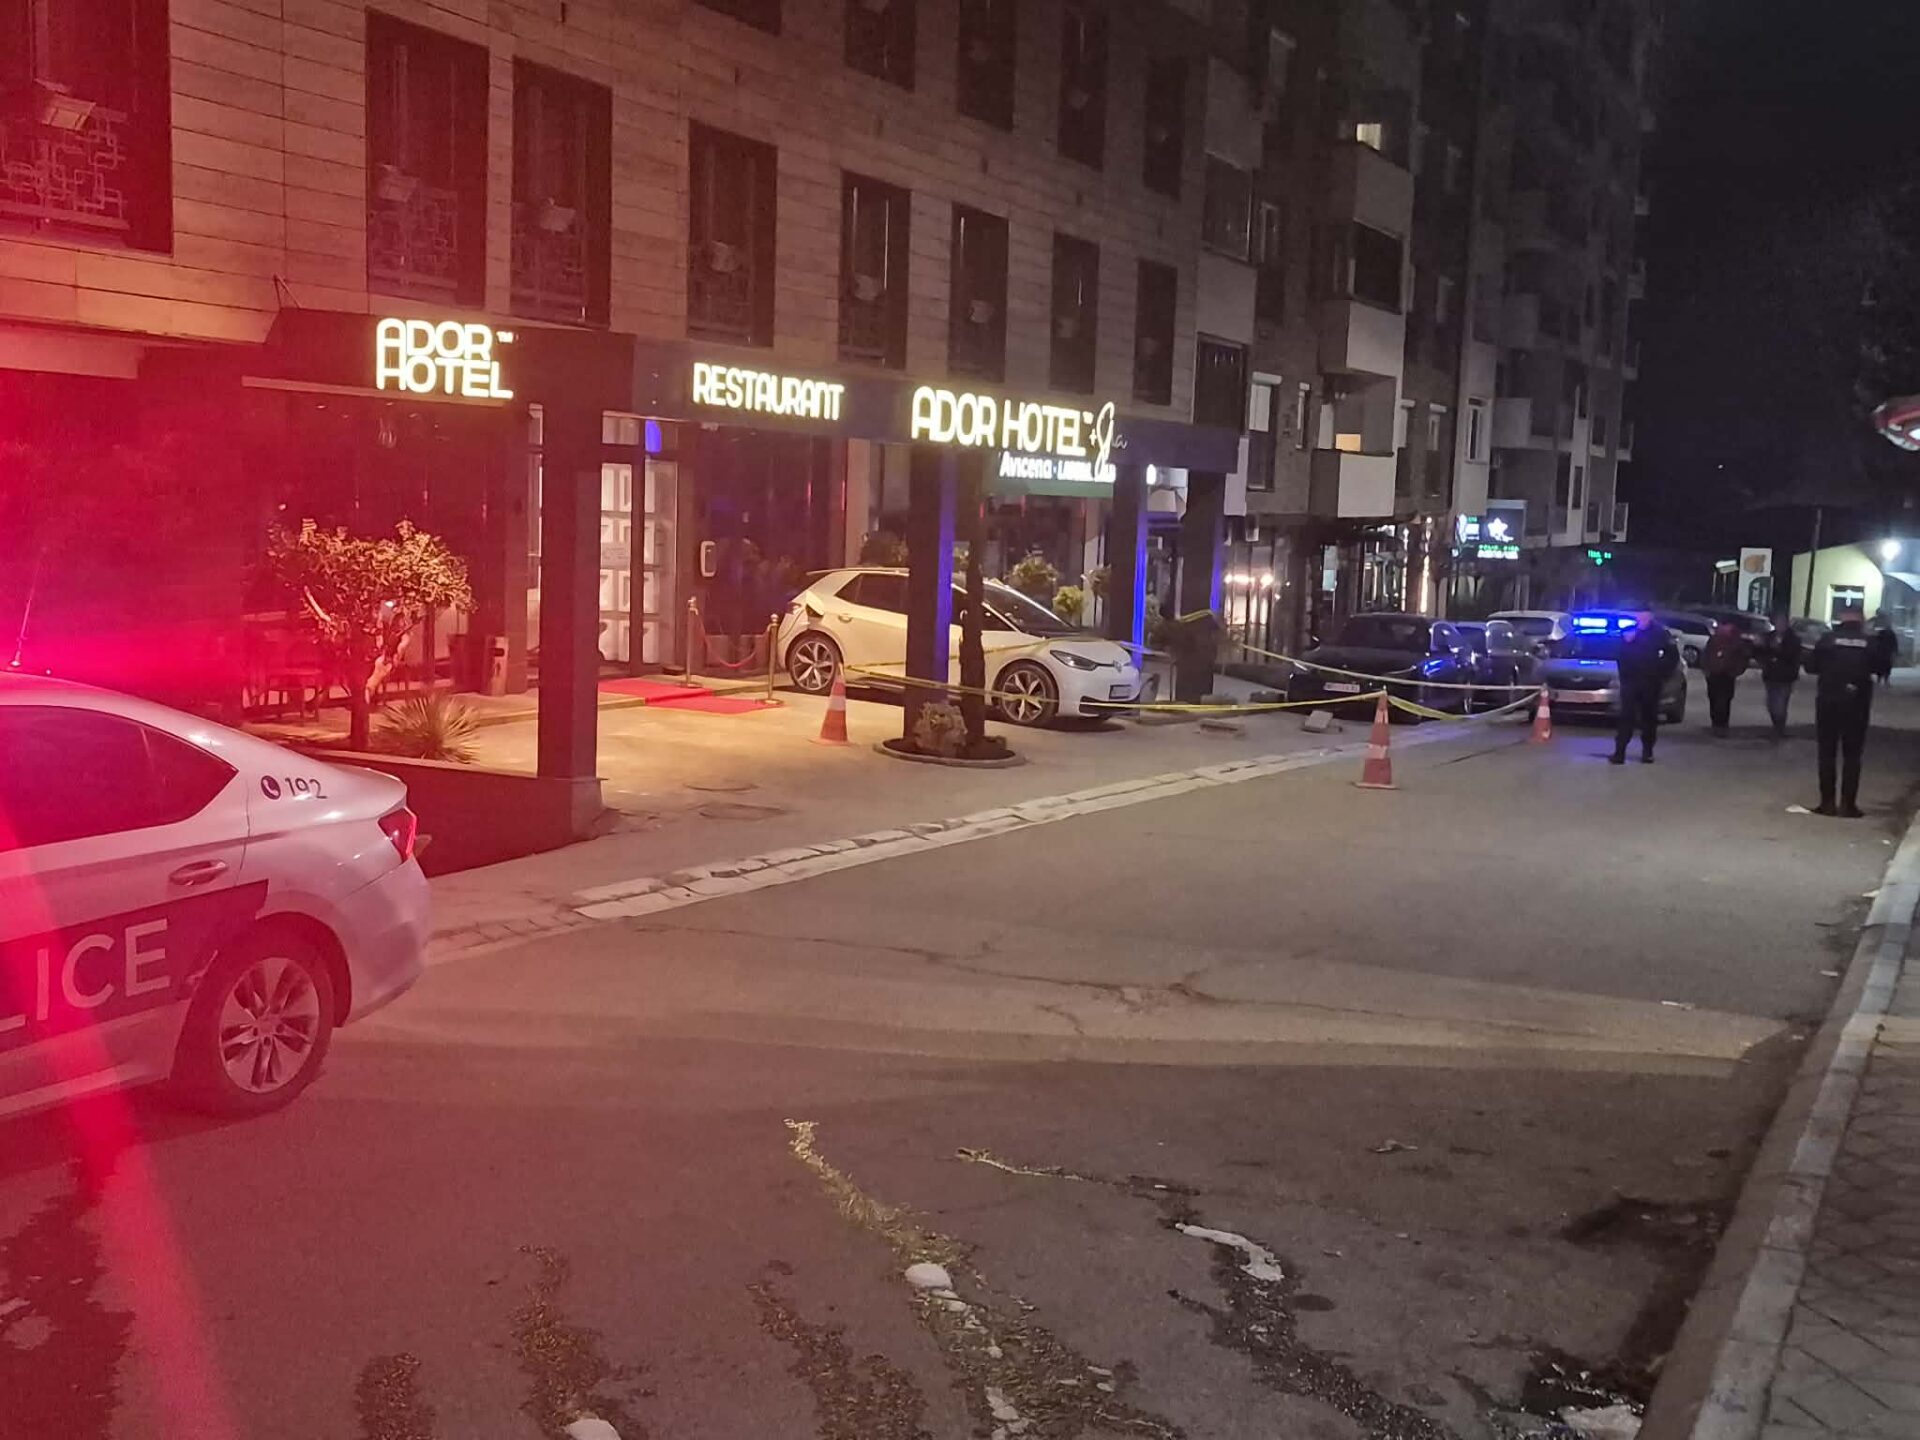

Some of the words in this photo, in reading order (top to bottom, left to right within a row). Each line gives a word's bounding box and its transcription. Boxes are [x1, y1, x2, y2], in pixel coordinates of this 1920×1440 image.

[376, 318, 492, 361] ADOR
[376, 356, 514, 399] HOTEL
[692, 362, 845, 421] RESTAURANT
[911, 386, 997, 447] ADOR
[1002, 399, 1086, 457] HOTEL
[284, 777, 327, 799] 192
